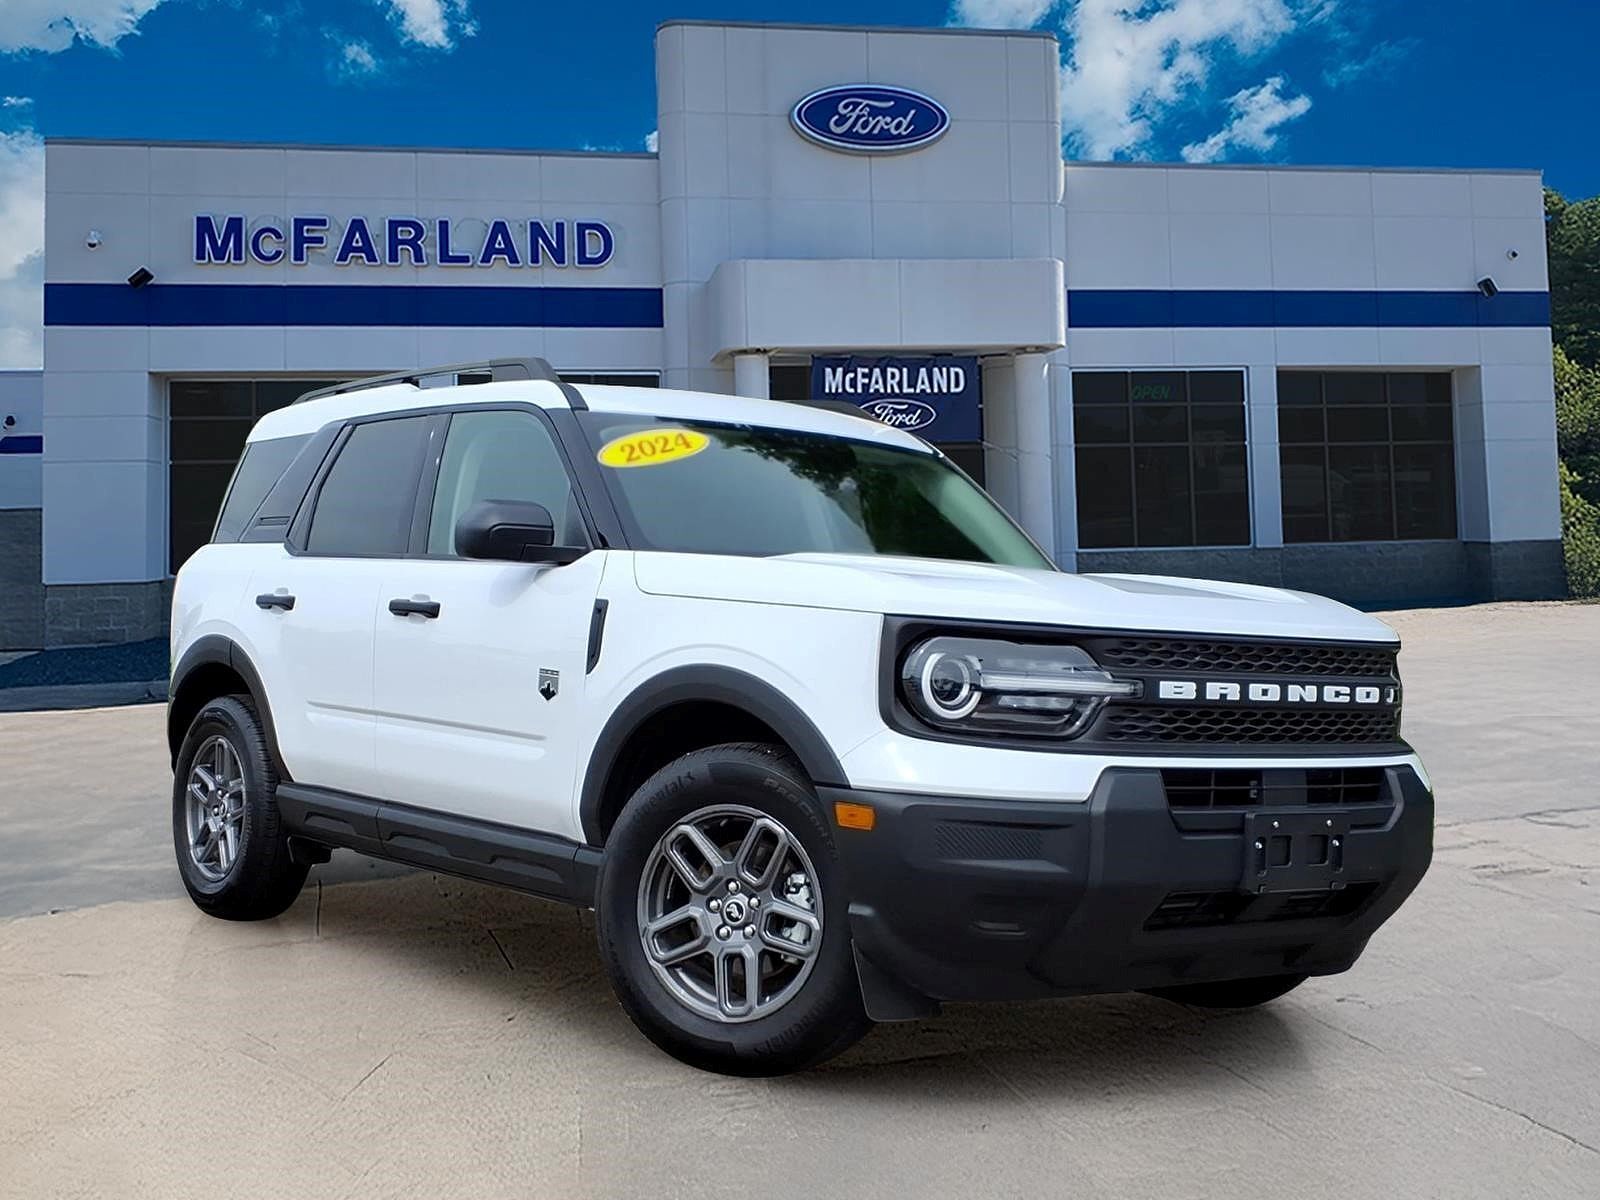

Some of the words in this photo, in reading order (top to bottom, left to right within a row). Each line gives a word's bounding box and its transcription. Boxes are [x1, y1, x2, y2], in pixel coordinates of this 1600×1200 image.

[829, 97, 916, 135] Ford
[193, 214, 616, 268] McFARLAND
[824, 366, 966, 394] McFARLAND
[1132, 385, 1170, 401] OPEN
[871, 402, 921, 427] Ford
[620, 433, 693, 463] 2024
[1158, 680, 1381, 704] BRONCO
